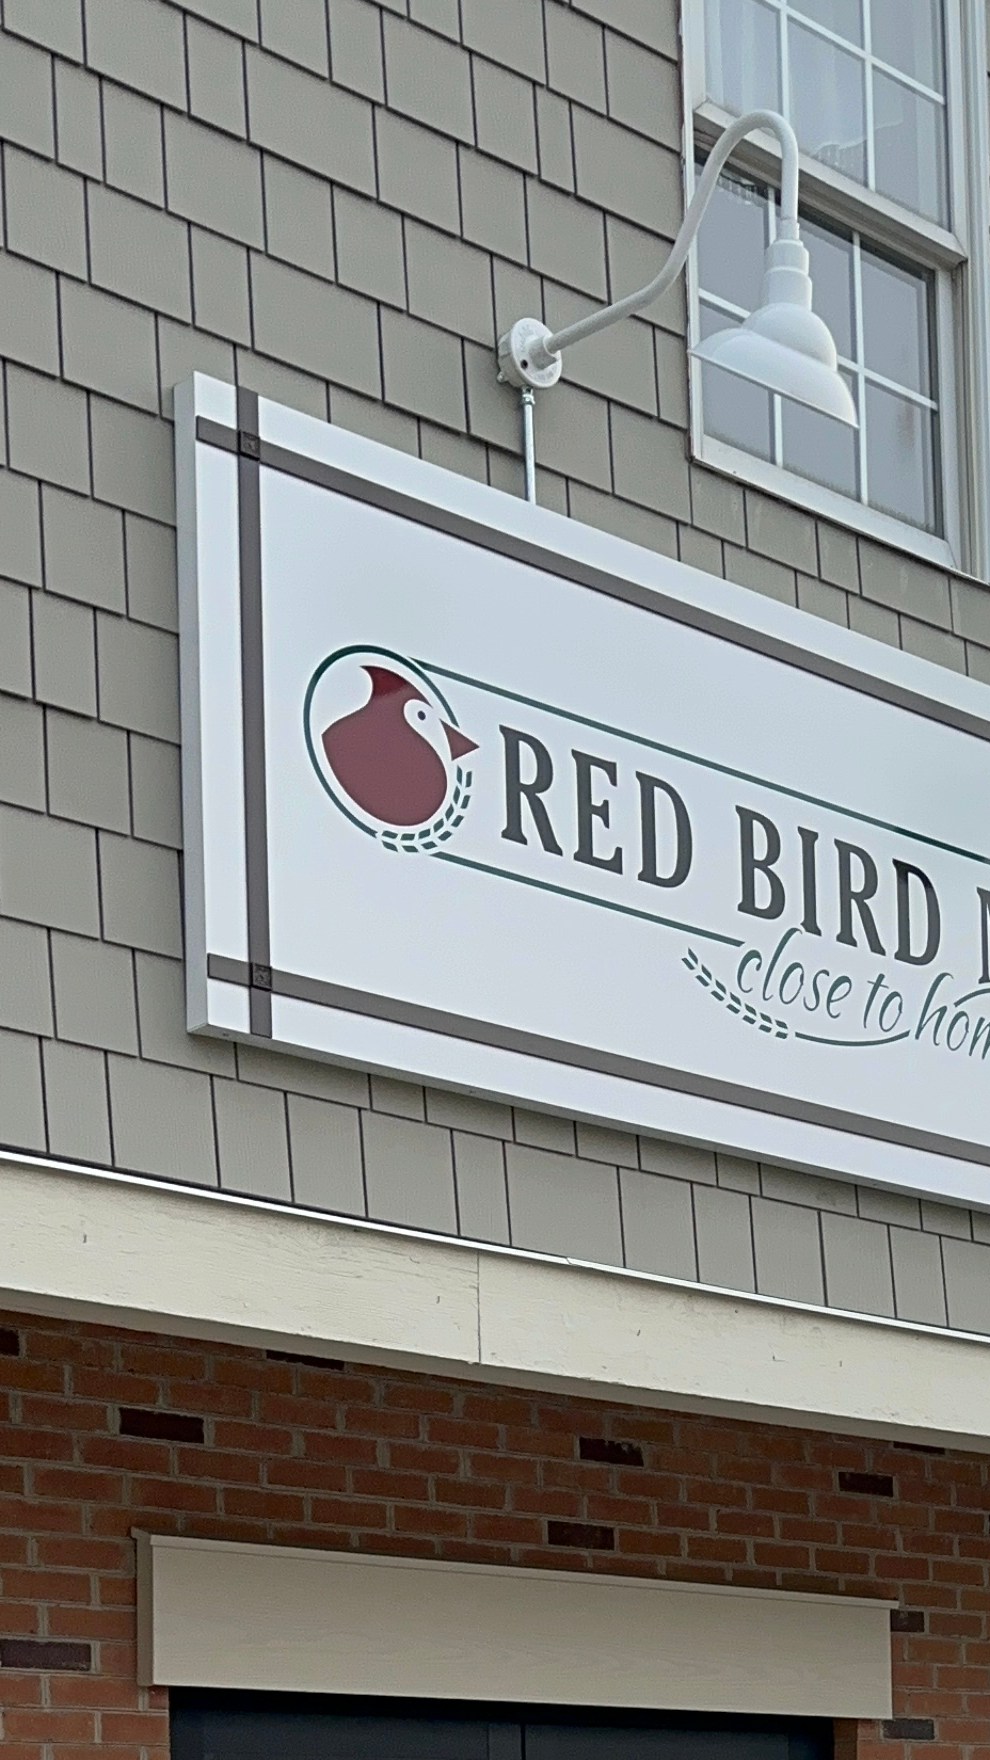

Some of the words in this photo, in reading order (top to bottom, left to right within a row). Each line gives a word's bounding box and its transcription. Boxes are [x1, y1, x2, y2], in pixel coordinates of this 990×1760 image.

[501, 725, 693, 888] RED
[735, 804, 941, 966] BIRD
[737, 927, 852, 1019] close
[863, 973, 904, 1032] to
